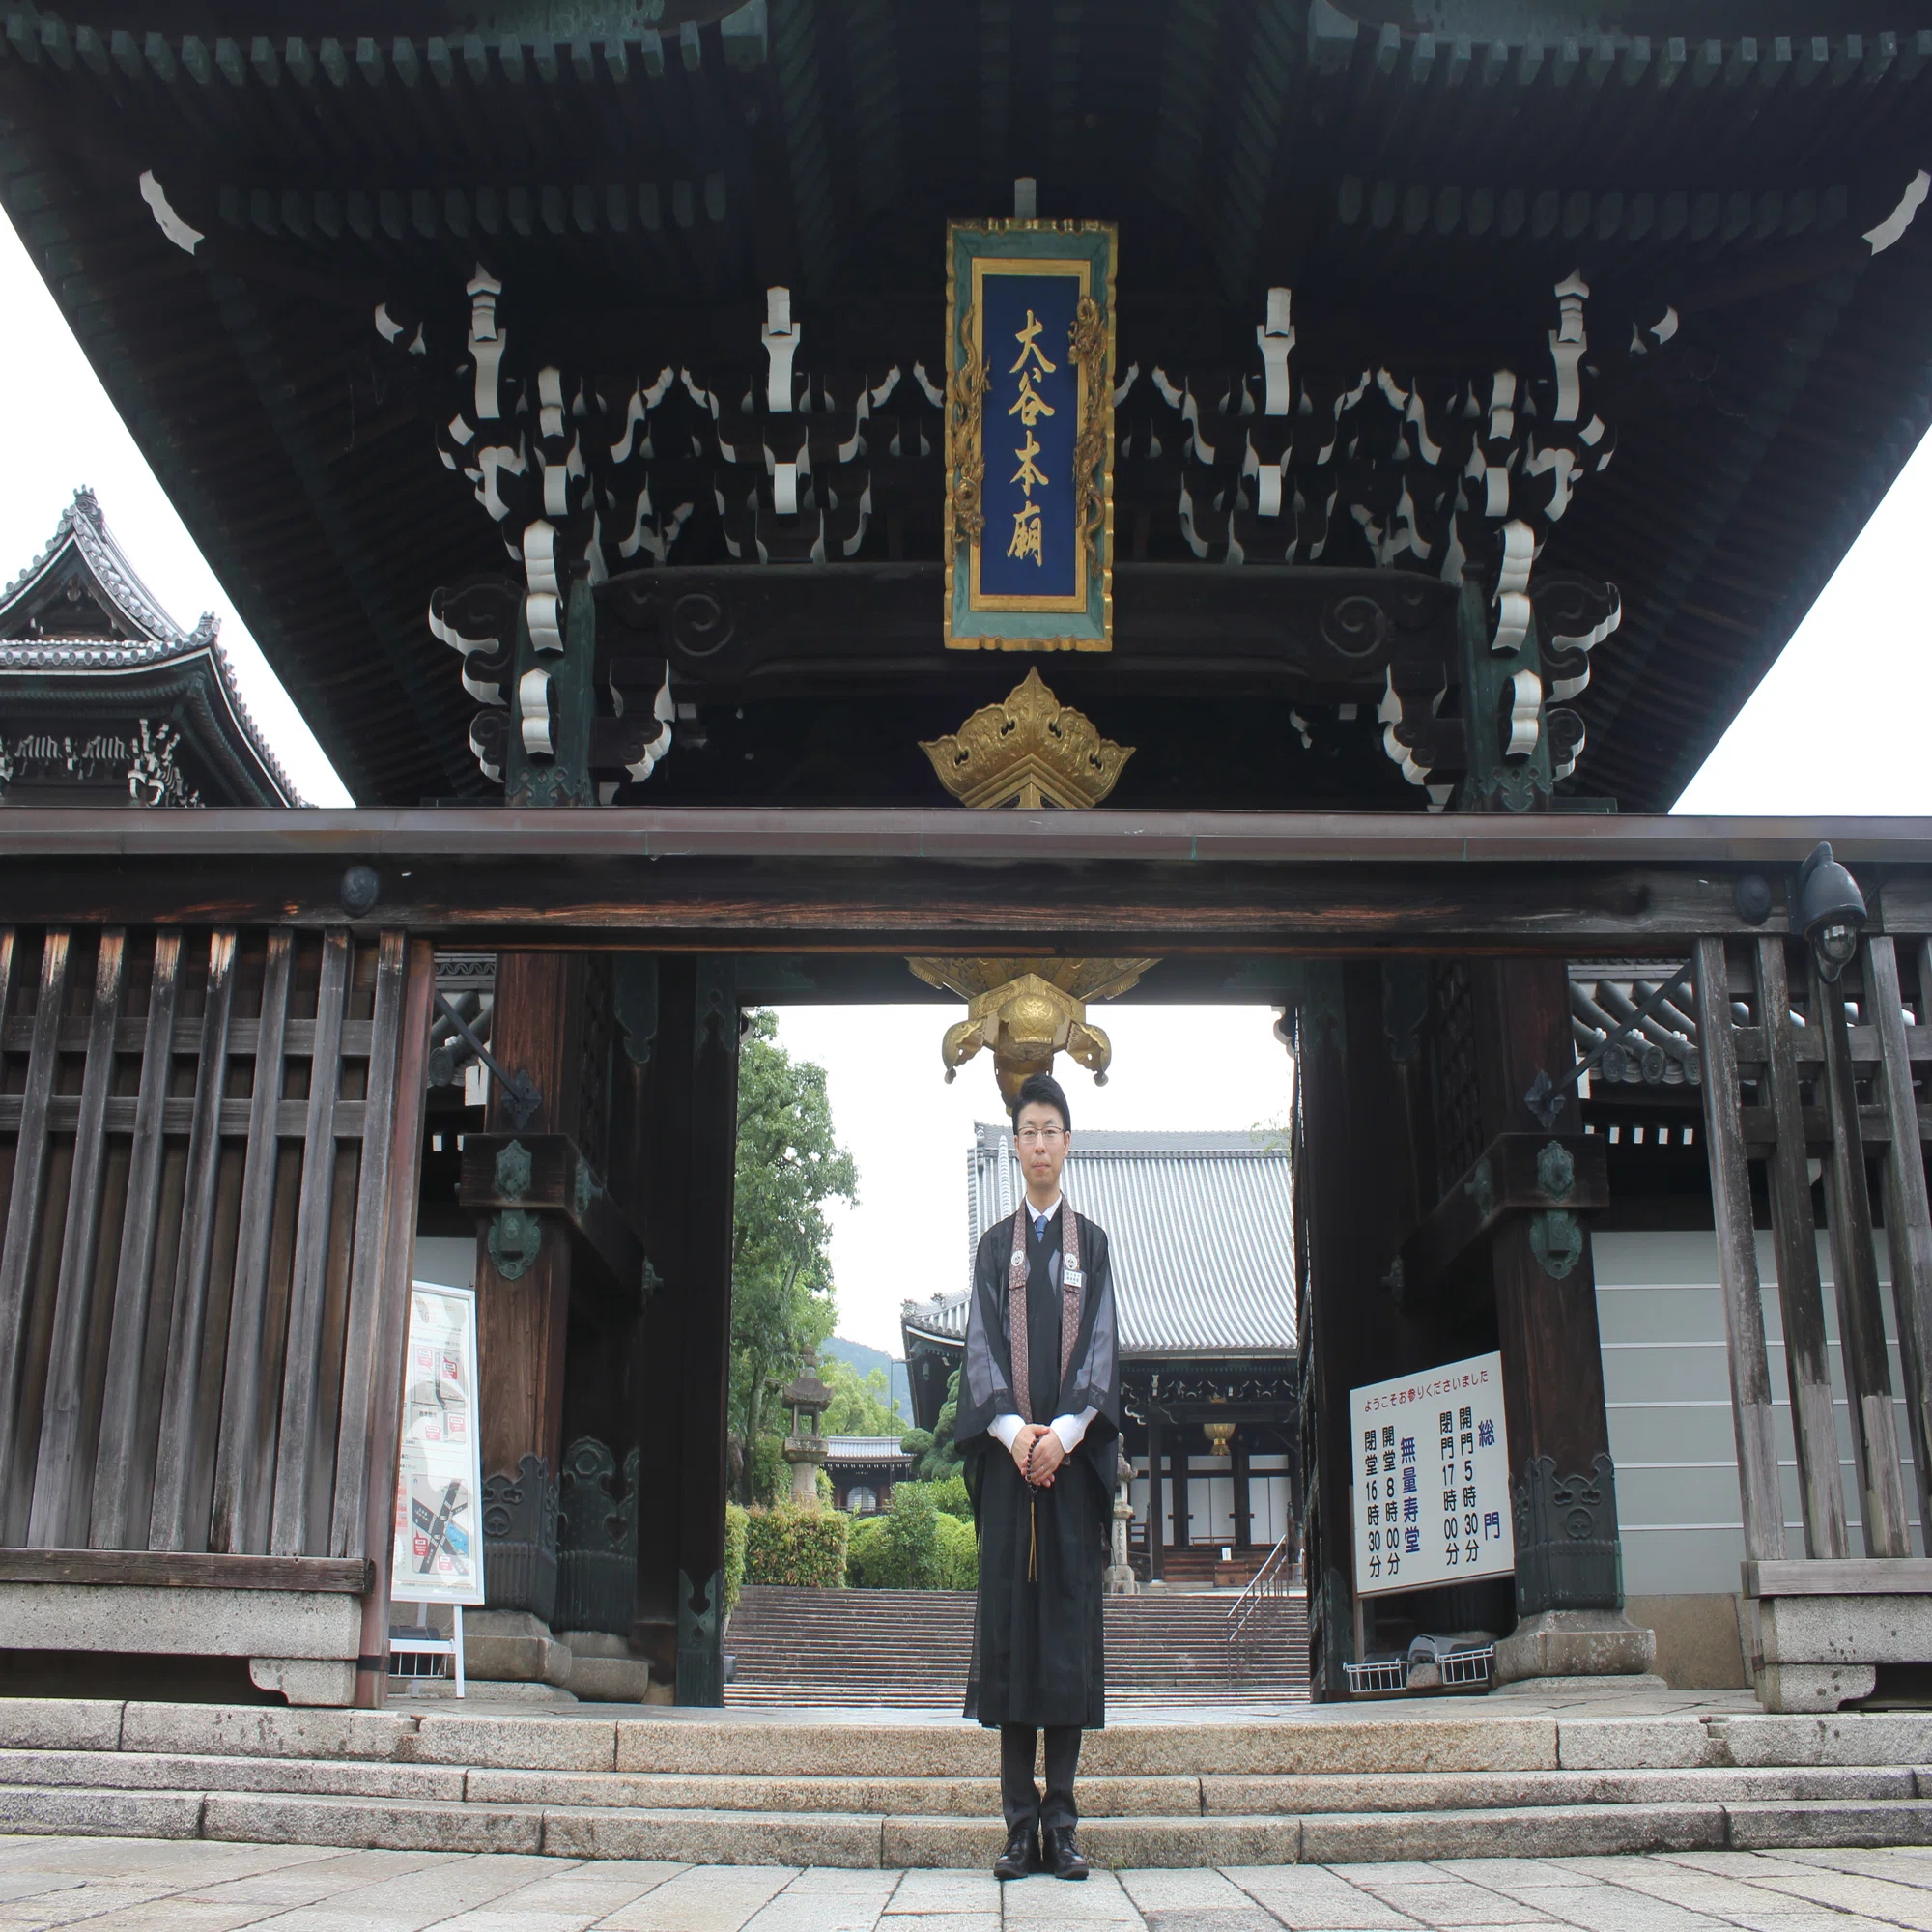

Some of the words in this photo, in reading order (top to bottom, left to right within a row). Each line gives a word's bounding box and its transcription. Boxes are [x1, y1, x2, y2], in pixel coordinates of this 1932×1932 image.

[1006, 309, 1057, 567] 大谷本廟
[1364, 1370, 1489, 1412] ようこそお参りくださいました
[1400, 1436, 1420, 1554] 無量寿堂
